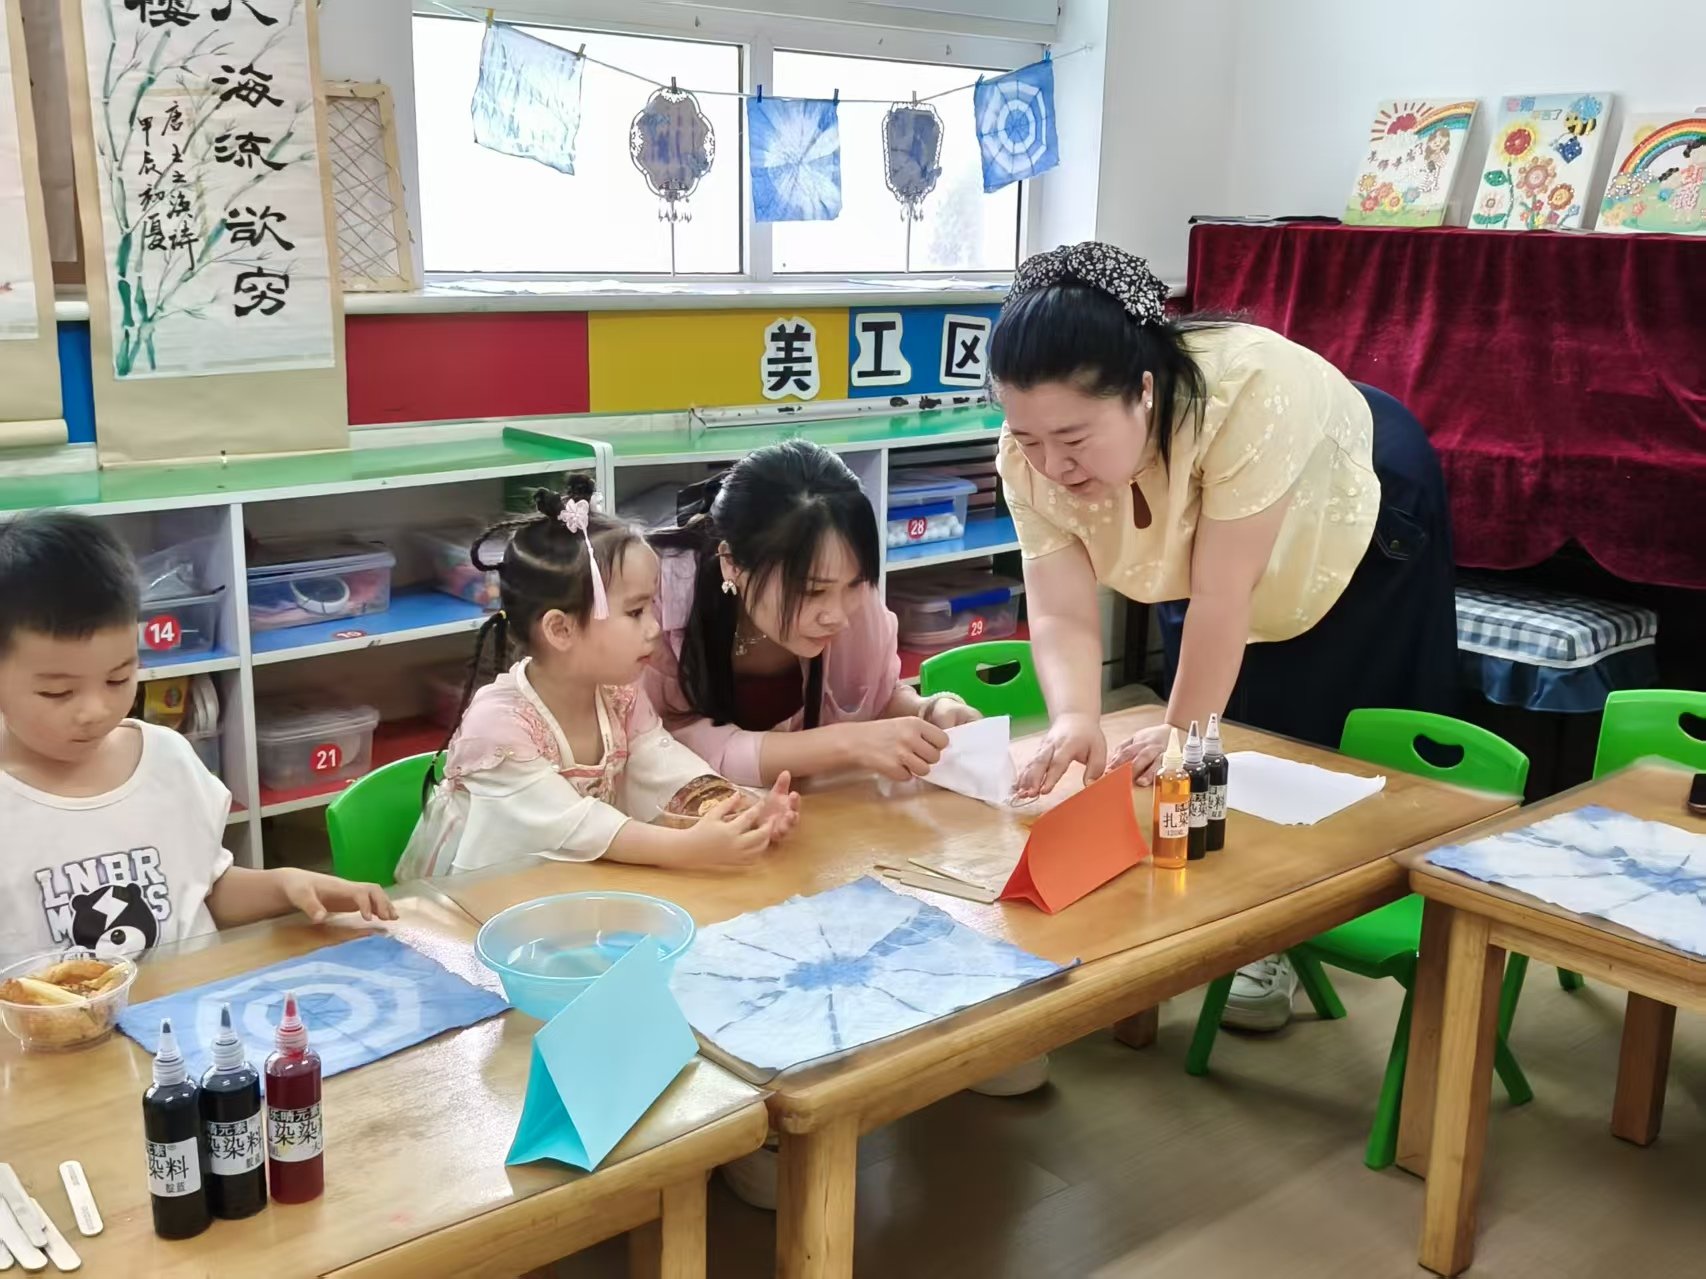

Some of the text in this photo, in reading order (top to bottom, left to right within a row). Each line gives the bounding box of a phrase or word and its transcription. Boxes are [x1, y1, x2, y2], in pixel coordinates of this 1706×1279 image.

[767, 322, 986, 392] 美工区
[910, 519, 925, 536] 28
[149, 621, 176, 644] 14
[970, 619, 984, 637] 29
[315, 748, 337, 770] 21
[34, 846, 166, 909] LNBR
